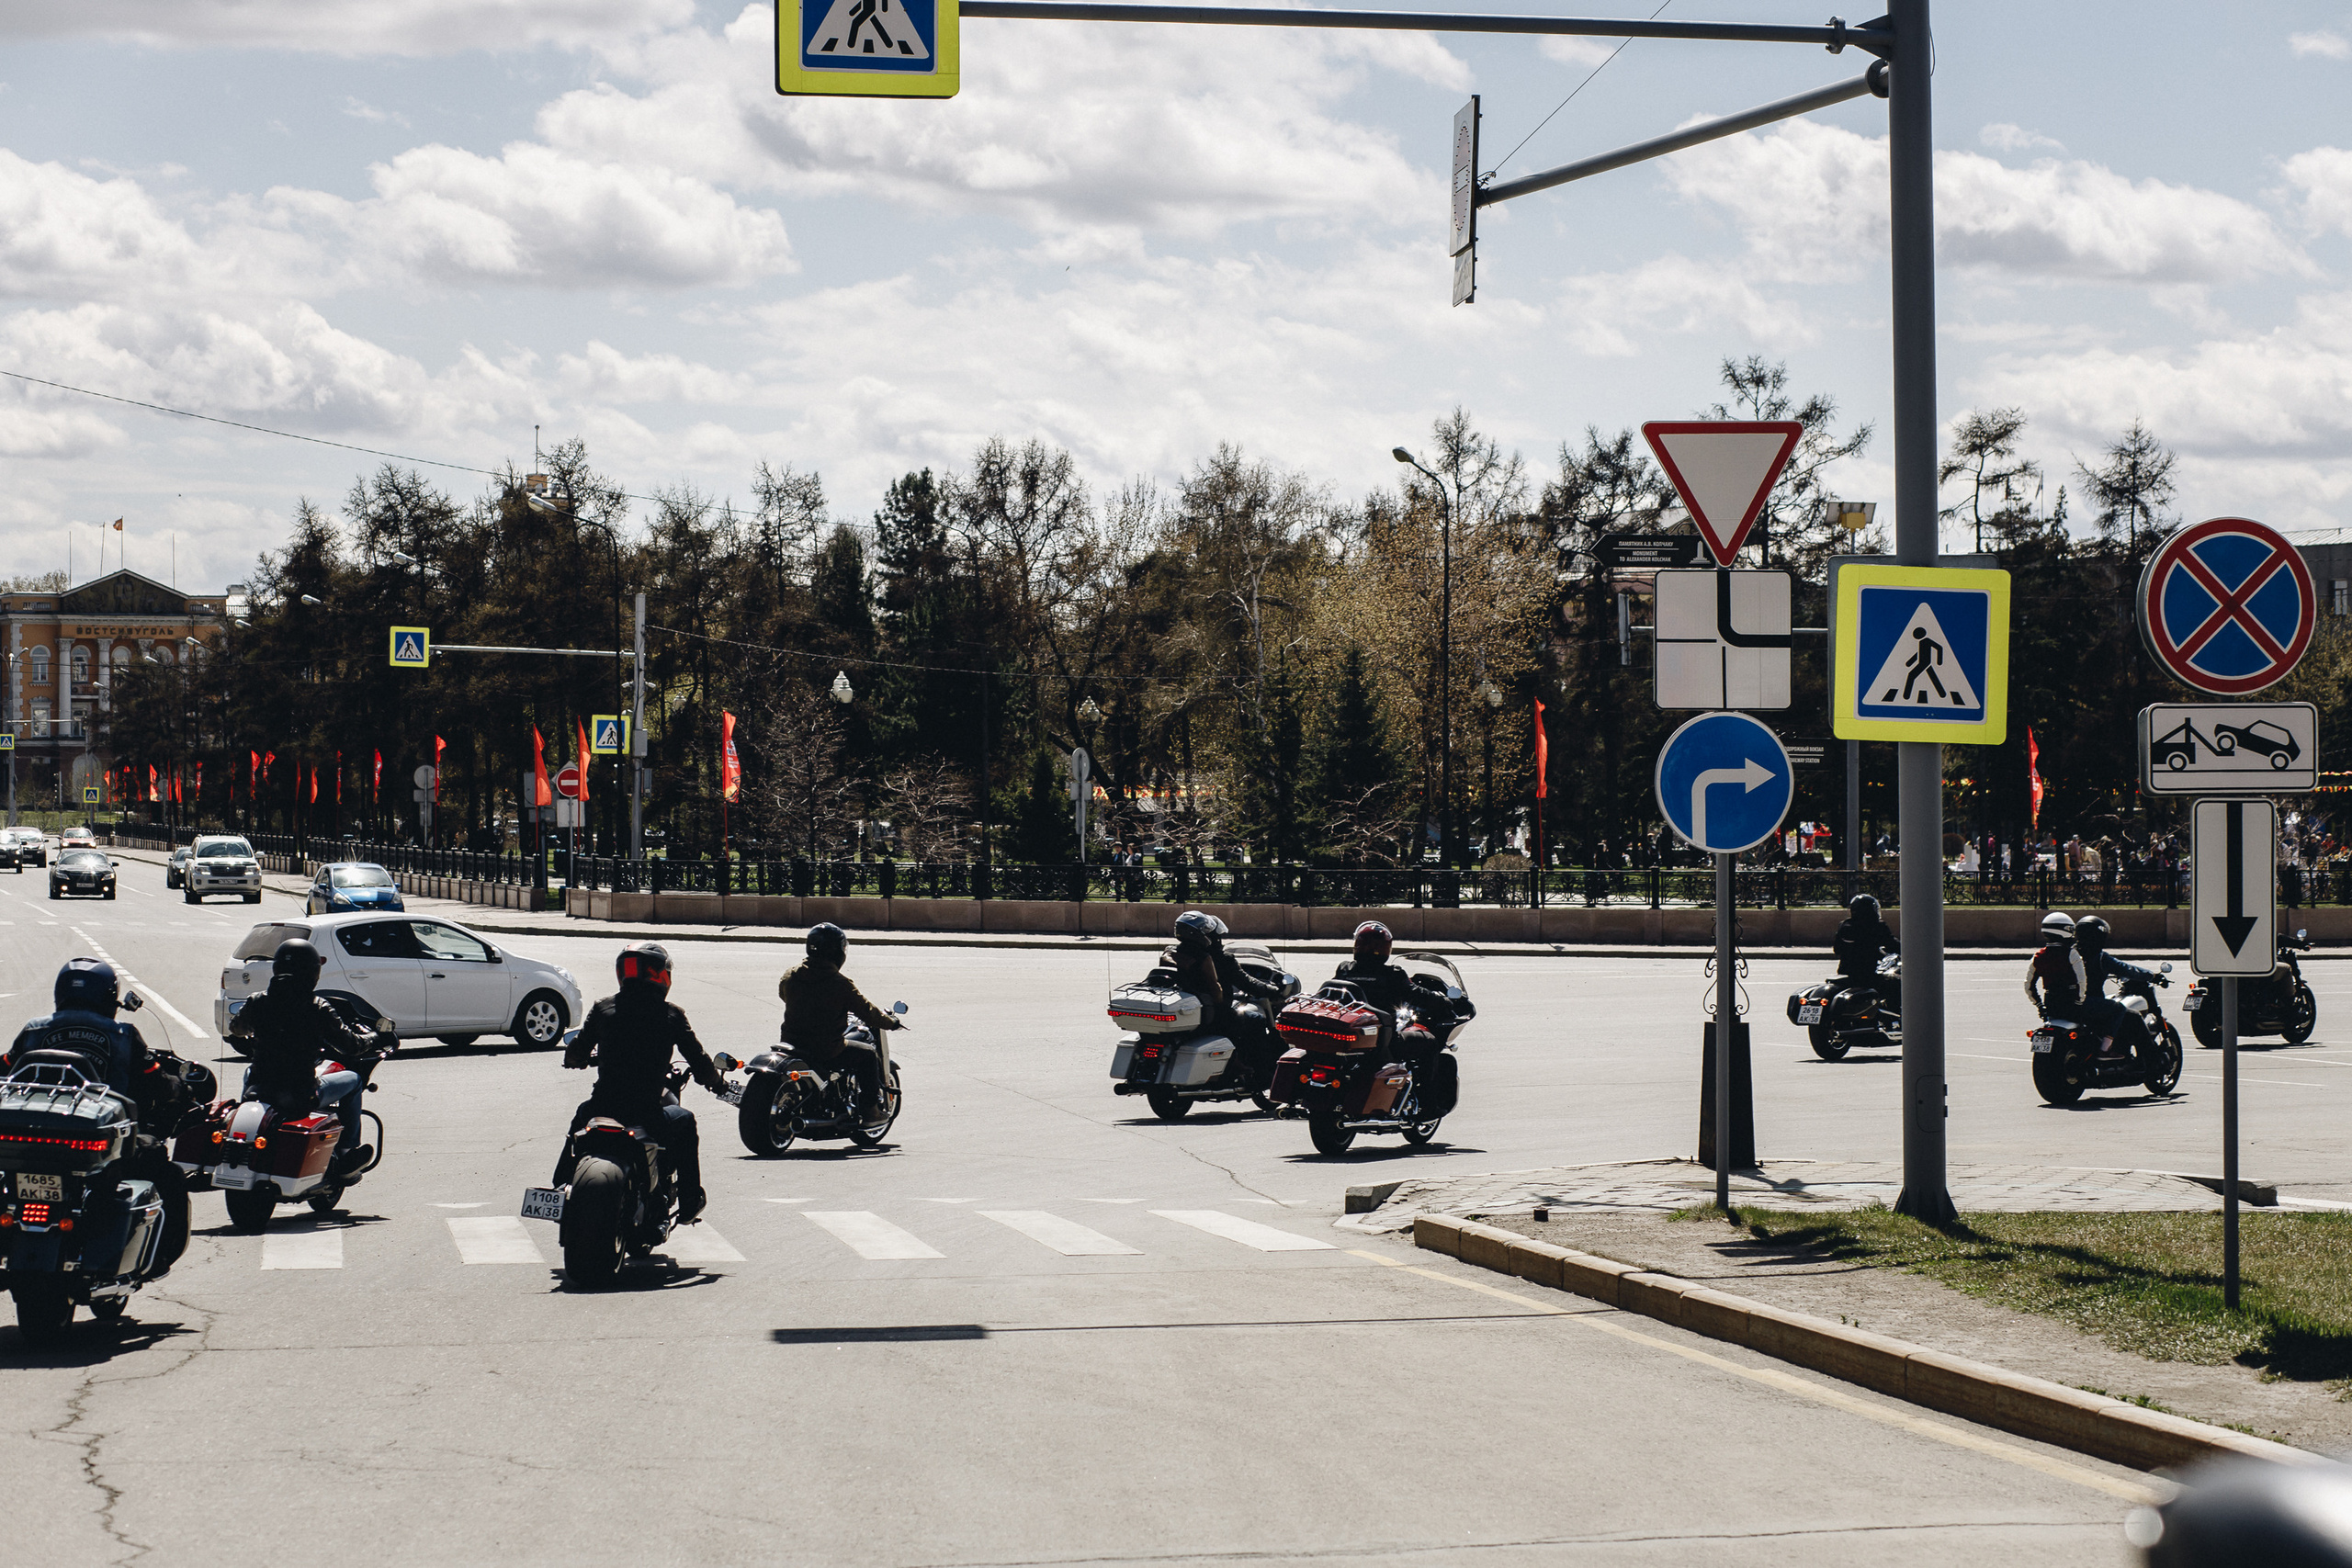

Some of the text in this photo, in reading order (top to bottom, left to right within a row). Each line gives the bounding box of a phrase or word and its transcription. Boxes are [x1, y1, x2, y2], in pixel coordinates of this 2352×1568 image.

[76, 626, 175, 636] ВОСТСИБУГОЛЬ
[46, 1031, 106, 1045] LIFE MEMBER
[23, 1174, 56, 1186] 1685
[43, 1190, 61, 1201] 38
[531, 1191, 560, 1204] 1108
[544, 1207, 560, 1218] 38
